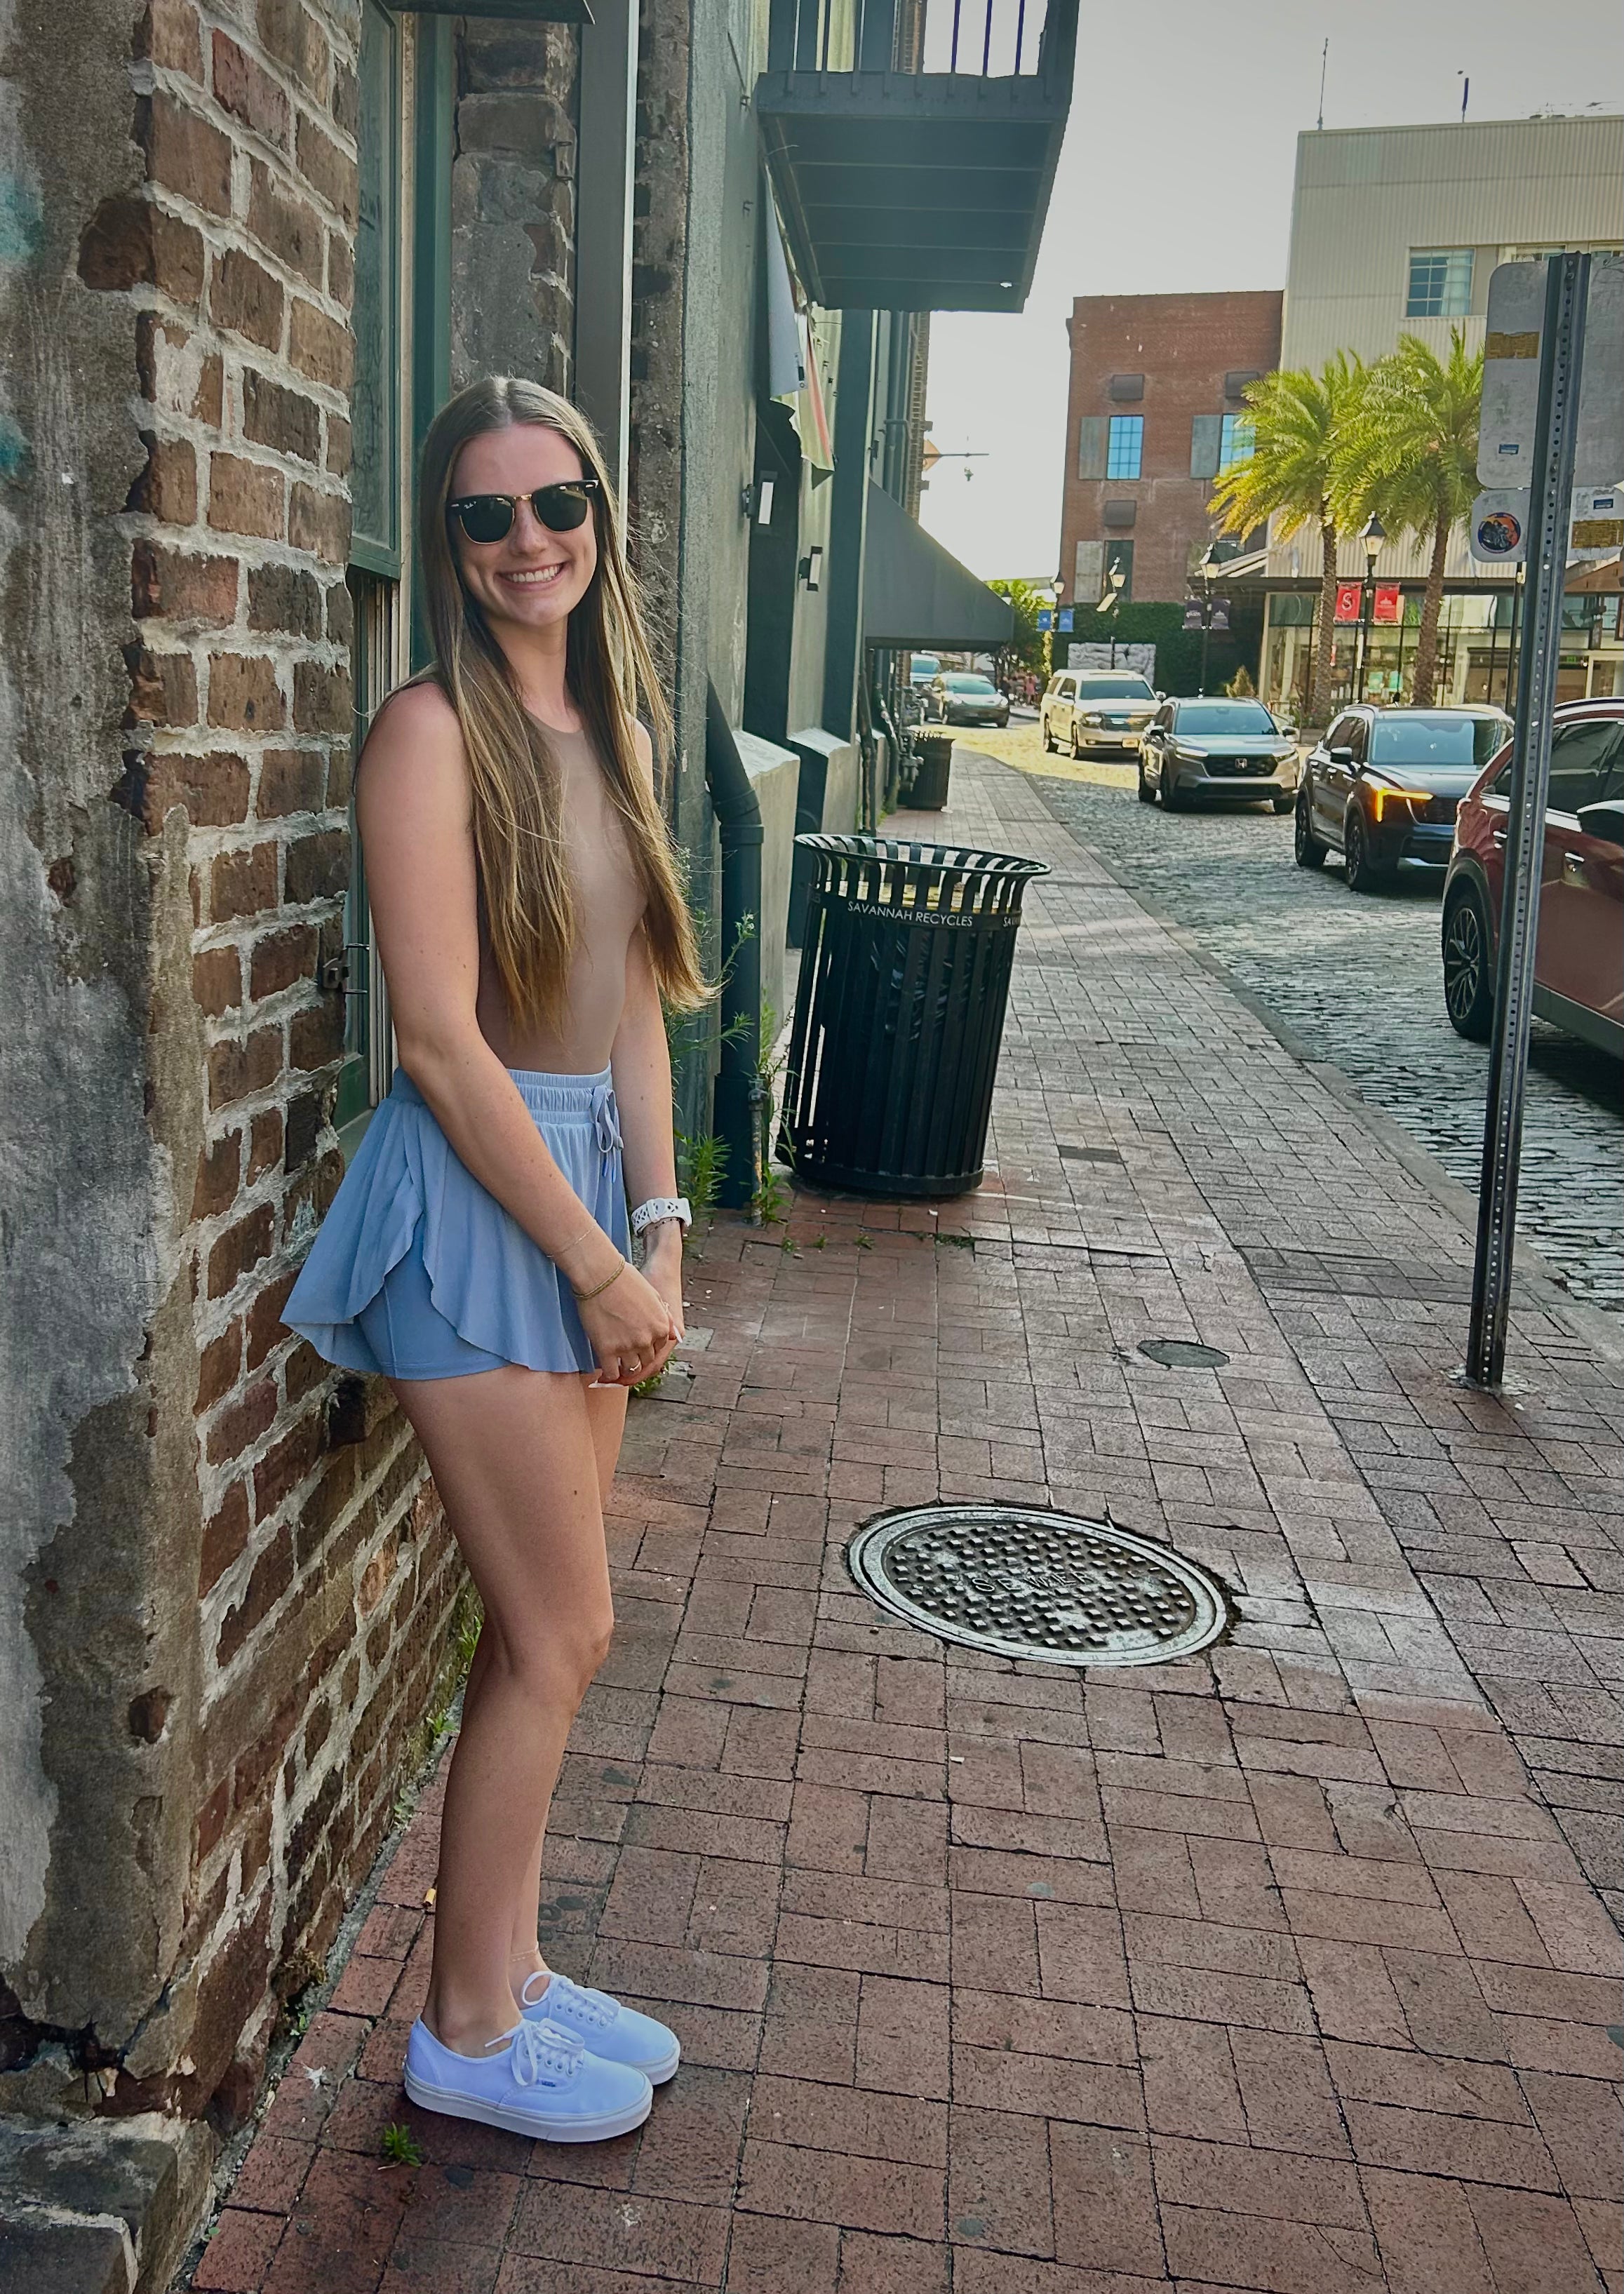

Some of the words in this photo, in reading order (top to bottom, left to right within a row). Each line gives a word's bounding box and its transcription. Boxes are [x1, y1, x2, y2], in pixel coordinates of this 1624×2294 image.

[847, 901, 912, 920] SAVANNAH
[915, 911, 973, 927] RECYCLES
[972, 1569, 1094, 1592] SEWER
